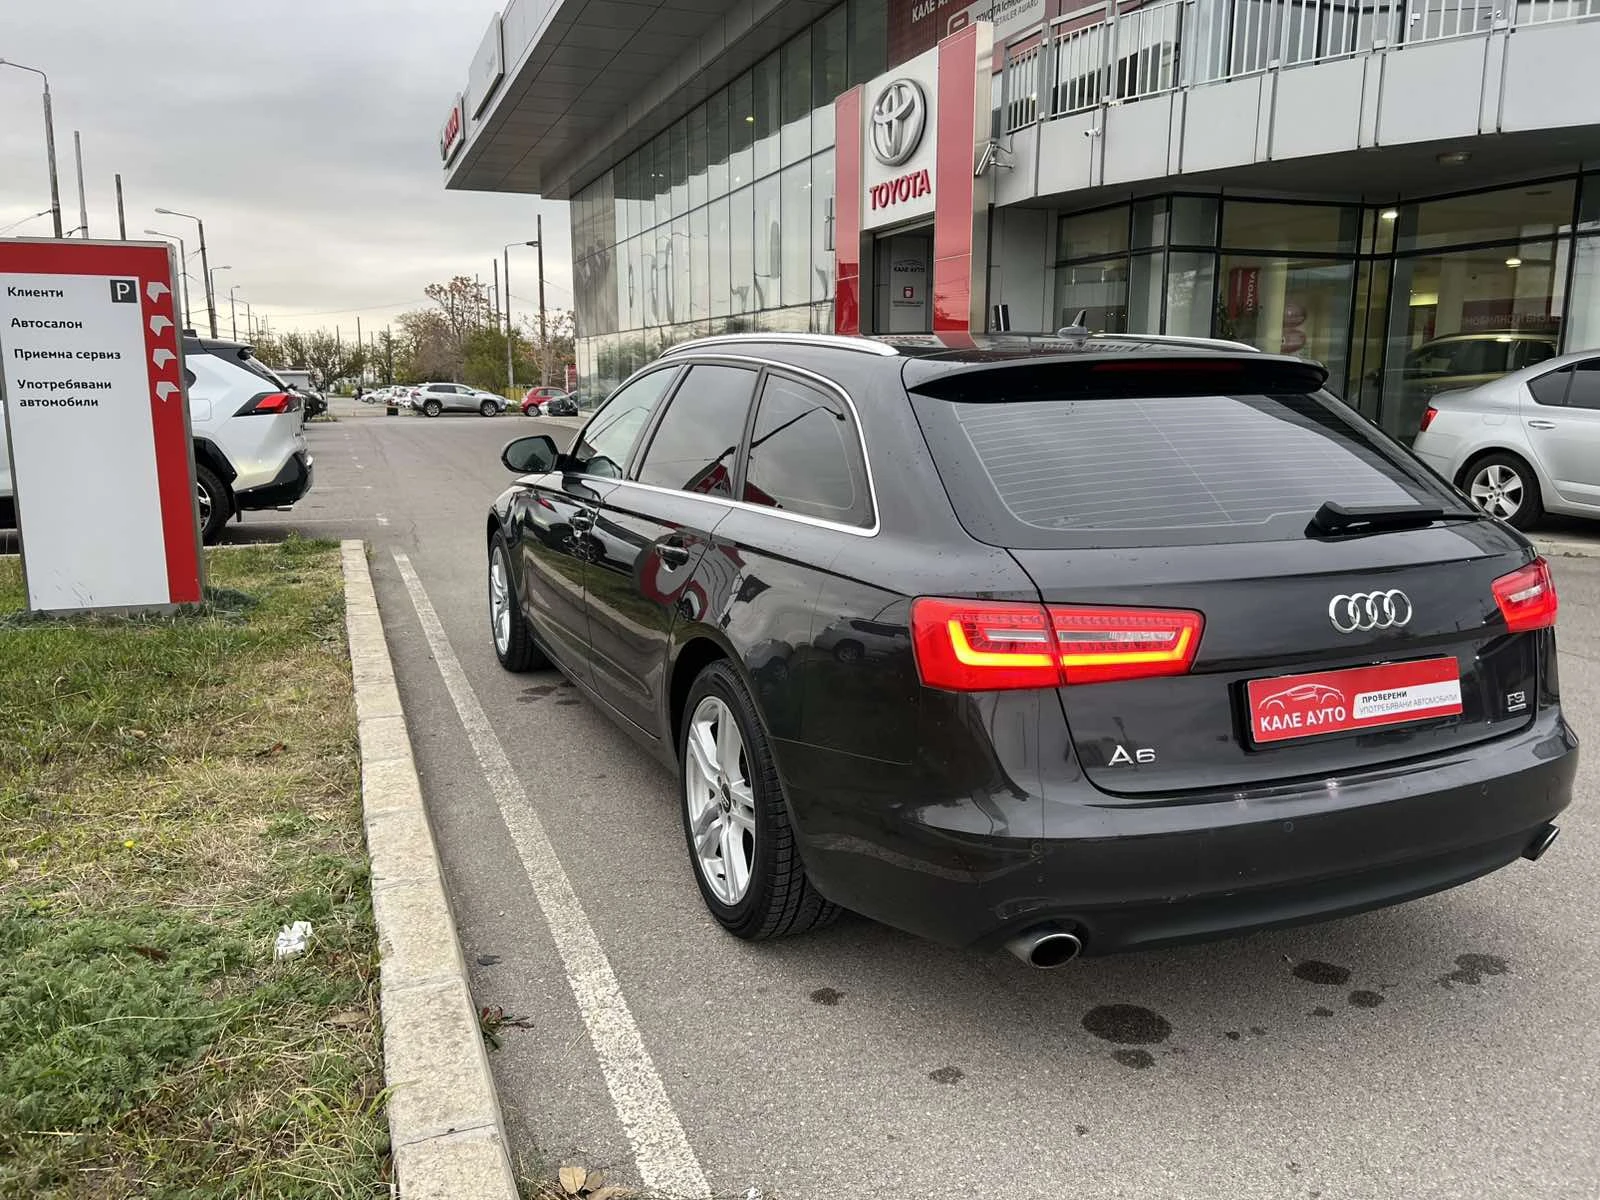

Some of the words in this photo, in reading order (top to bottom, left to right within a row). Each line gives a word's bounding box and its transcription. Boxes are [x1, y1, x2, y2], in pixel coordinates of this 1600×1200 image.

[869, 169, 931, 210] TOYOTA
[7, 286, 64, 298] Клиенти
[116, 282, 130, 301] P
[10, 317, 83, 329] Автосалон
[14, 348, 73, 361] Приемна
[75, 351, 121, 361] сервиз
[17, 379, 112, 391] Употребявани
[19, 397, 99, 407] автомобили
[1362, 691, 1408, 704] ПРОВЕРЕНИ
[1260, 712, 1303, 732] КАЛЕ
[1306, 706, 1346, 726] АУТО
[1108, 745, 1156, 766] A6
